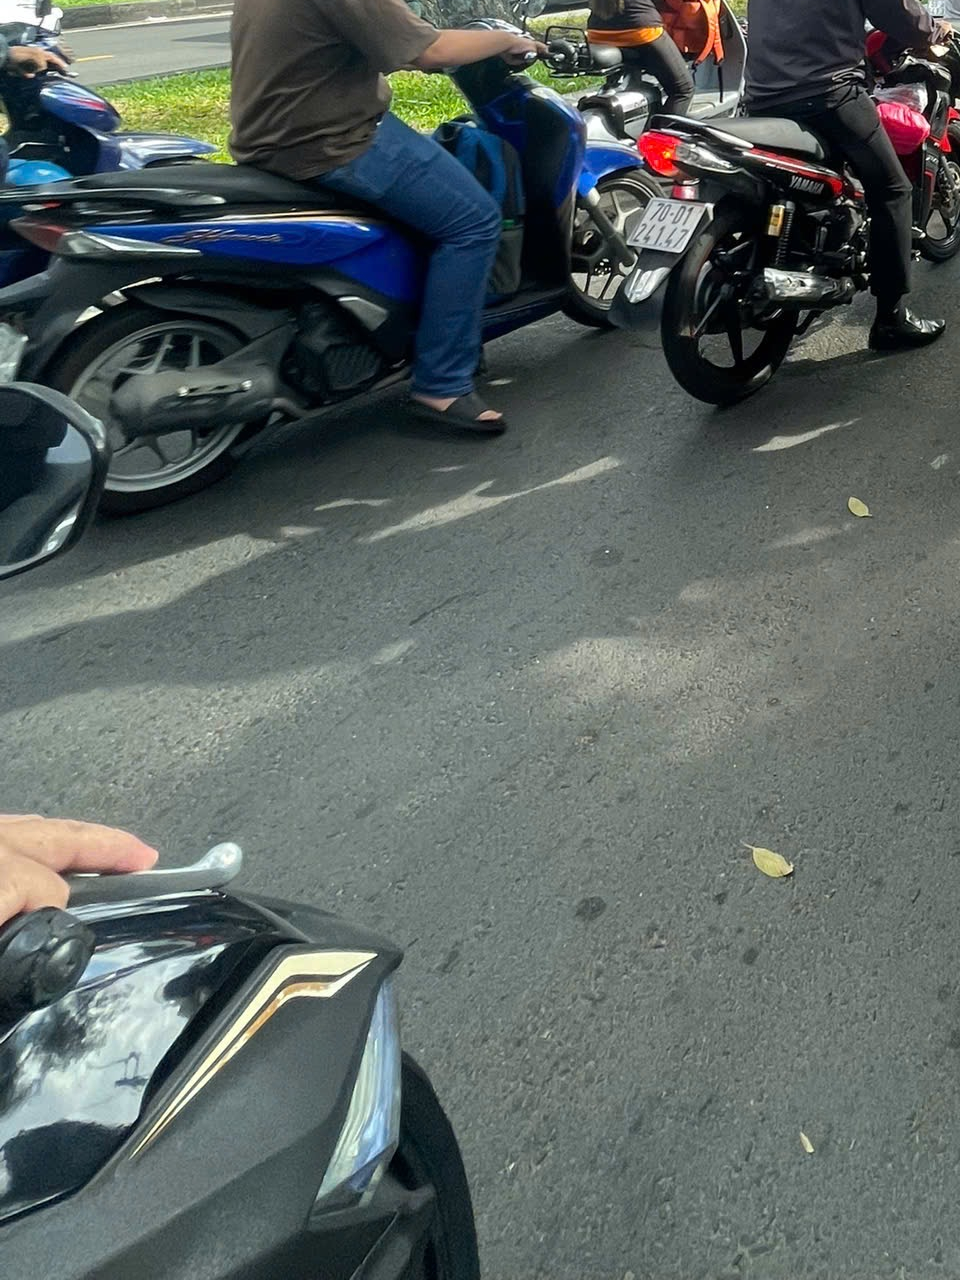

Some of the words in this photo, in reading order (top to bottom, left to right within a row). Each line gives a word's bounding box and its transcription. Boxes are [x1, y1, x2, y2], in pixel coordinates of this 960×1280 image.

[789, 175, 825, 195] YAMAHA
[650, 203, 696, 226] 70-D1
[633, 223, 690, 249] 241.47
